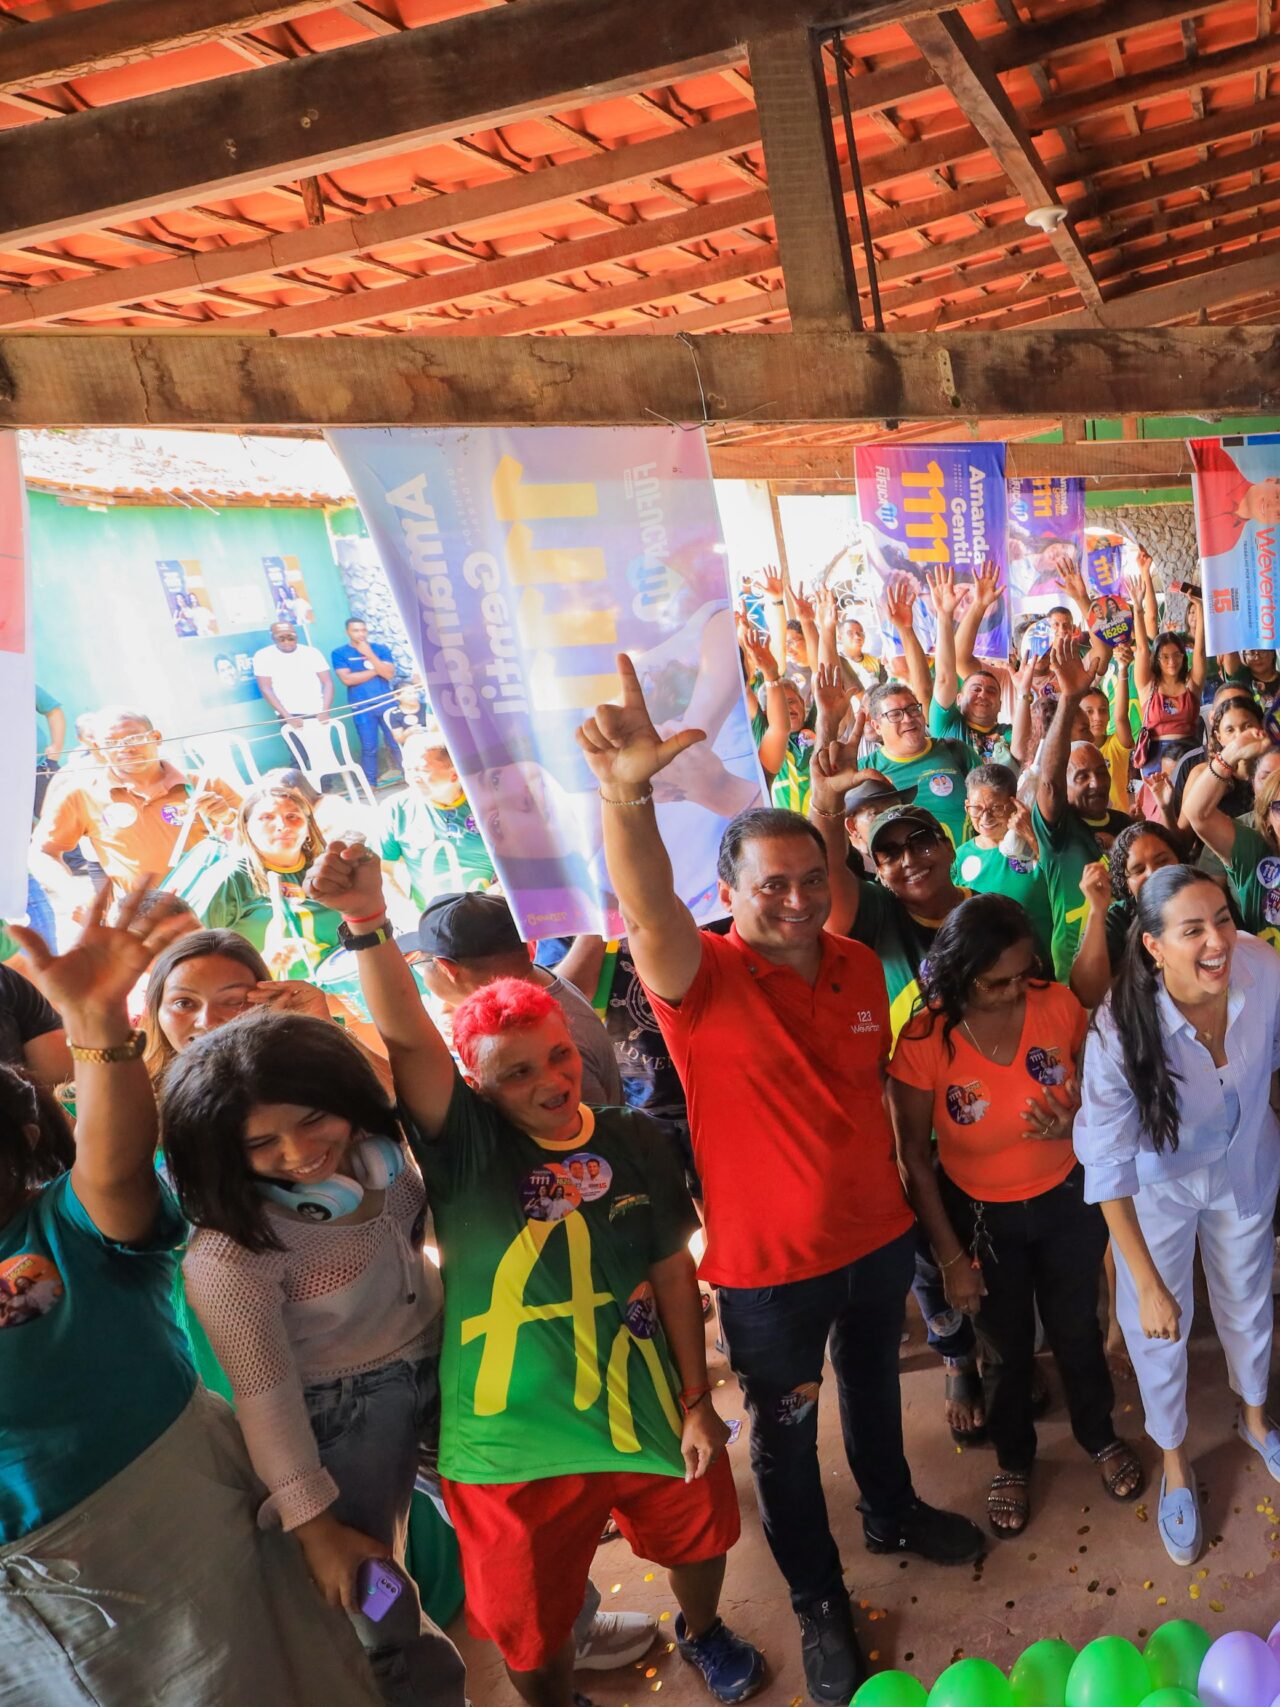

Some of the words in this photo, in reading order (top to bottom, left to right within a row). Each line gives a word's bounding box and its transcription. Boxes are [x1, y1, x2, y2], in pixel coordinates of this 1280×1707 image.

[875, 465, 888, 505] FUFUCA
[881, 506, 895, 523] 111
[901, 460, 950, 563] 1111
[950, 497, 972, 565] Gentil
[969, 465, 990, 565] Amanda
[1211, 588, 1232, 614] 15
[1255, 527, 1276, 640] Weverton
[857, 1010, 873, 1022] 123
[529, 1175, 550, 1185] 1111
